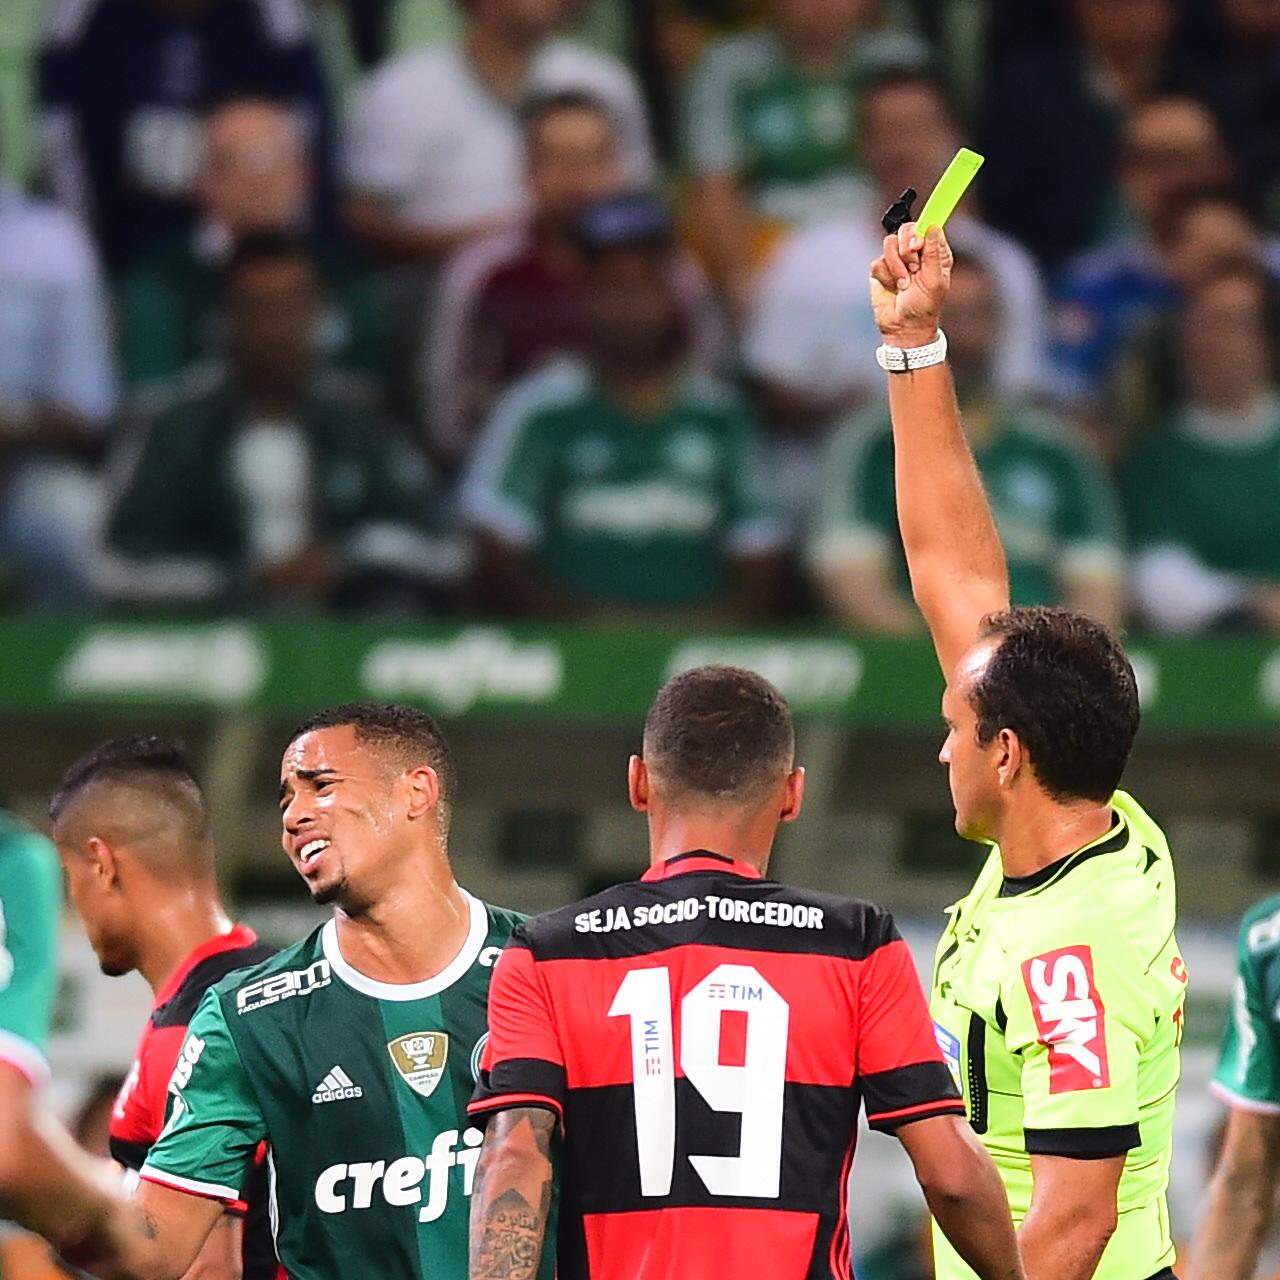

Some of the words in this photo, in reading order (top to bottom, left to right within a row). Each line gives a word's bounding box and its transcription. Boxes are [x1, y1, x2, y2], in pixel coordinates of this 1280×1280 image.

[574, 908, 632, 934] SEJA
[730, 985, 763, 1001] TIM
[1030, 954, 1102, 1078] SKY
[645, 1019, 659, 1054] TIM
[312, 1086, 363, 1104] adidas
[607, 963, 791, 1200] 19
